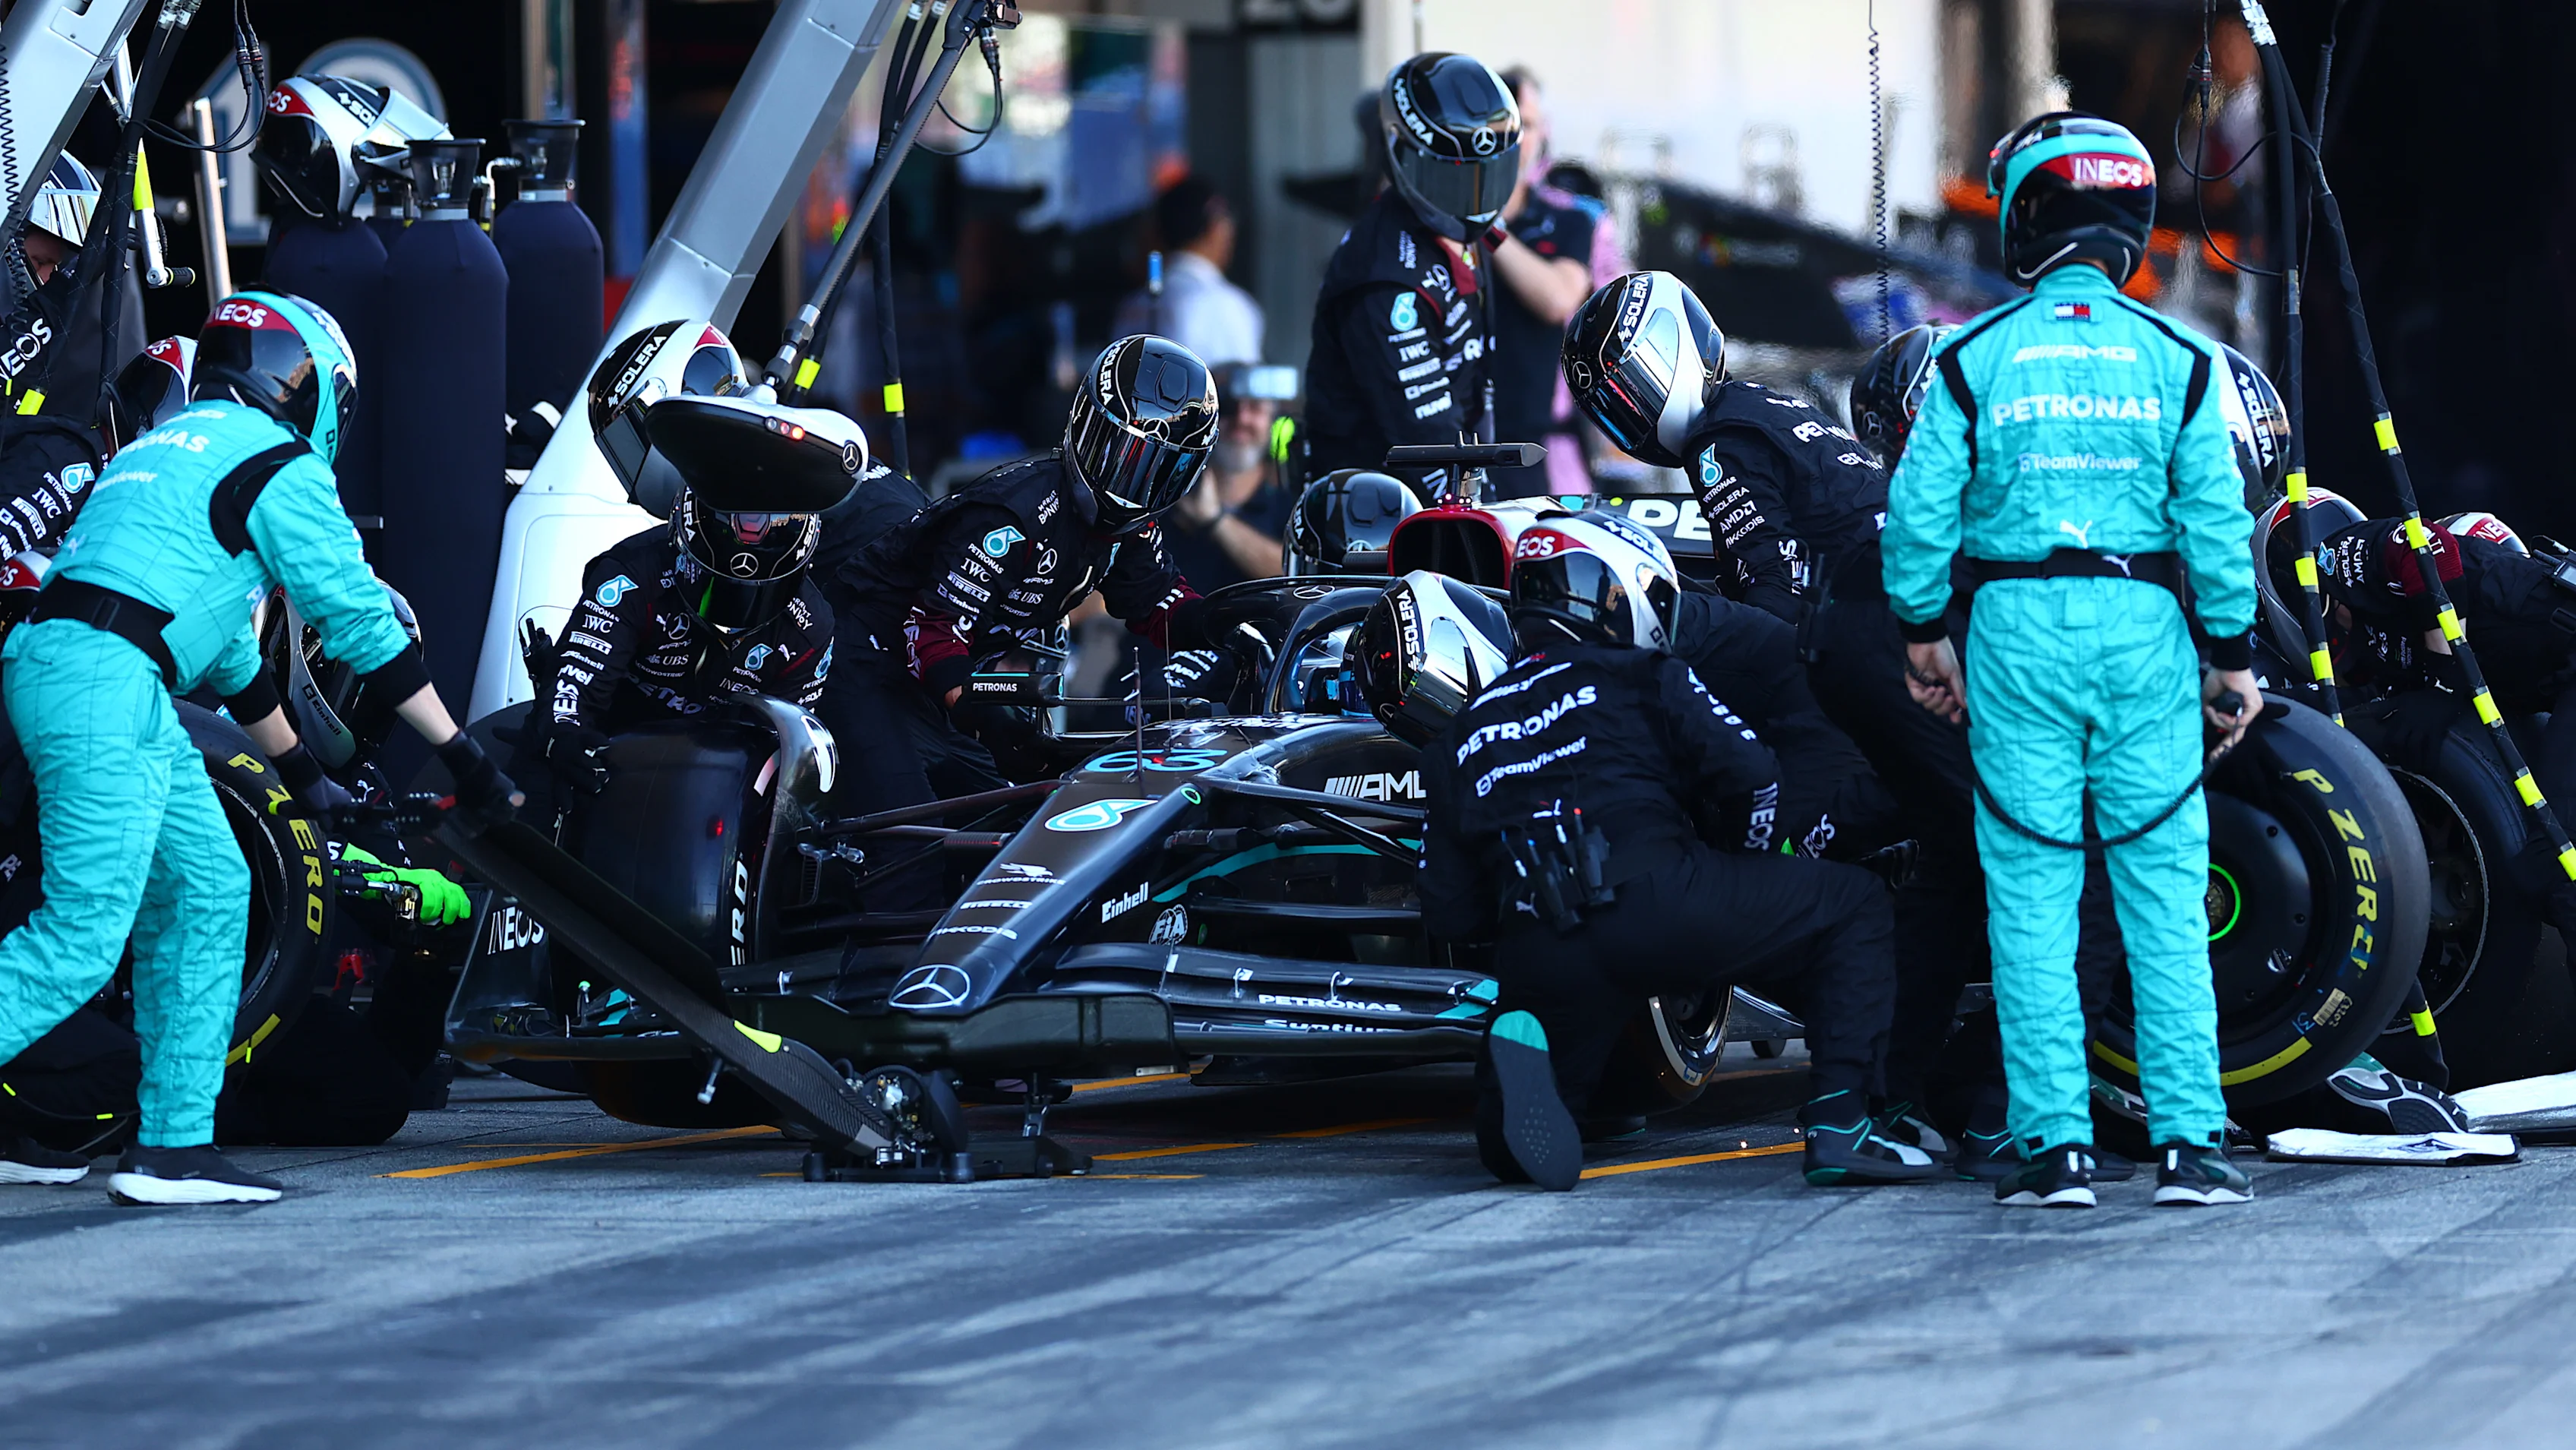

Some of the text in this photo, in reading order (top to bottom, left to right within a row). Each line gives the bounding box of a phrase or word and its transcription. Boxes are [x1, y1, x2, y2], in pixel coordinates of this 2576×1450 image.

[1394, 87, 1435, 146] SOLERA
[2074, 157, 2143, 187] INEOS
[213, 303, 267, 327] NEOS
[1623, 276, 1650, 327] SOLERA
[0, 318, 52, 381] NEOS
[614, 335, 667, 396] SOLERA
[1399, 341, 1430, 362] IWC
[2053, 345, 2137, 362] AMG
[1100, 346, 1122, 406] SOLERA
[1992, 394, 2162, 427] PETRONAS
[2242, 387, 2275, 467] SOLERA
[2033, 453, 2142, 470] TeamViewer
[32, 487, 62, 519] IWC
[43, 472, 73, 512] PETRONAS
[1703, 476, 1737, 503] PETRONAS
[1713, 487, 1750, 516] SOLERA
[11, 496, 46, 539] PIRELLI
[684, 486, 696, 542] LERA
[1719, 509, 1745, 534] AMD
[968, 543, 1004, 574] PETRONAS
[1517, 536, 1555, 558] EOS
[2341, 535, 2355, 581] SOLERA
[961, 558, 992, 582] IWC
[947, 570, 990, 603] PIRELLI
[1021, 592, 1043, 605] UBS
[582, 614, 614, 633] IWC
[1397, 589, 1421, 656] SOLERA
[569, 631, 612, 655] PIRELLI
[662, 655, 689, 665] UBS
[805, 688, 823, 703] SOLE
[973, 683, 1017, 691] PETRONAS
[312, 700, 341, 736] Einhell
[1457, 686, 1597, 768] PETRONAS
[1084, 748, 1228, 772] 63
[1489, 736, 1586, 782] TeamViewer
[1744, 782, 1778, 851] INEOS
[227, 752, 324, 936] P ZERO
[977, 877, 1066, 886] CROWDSTRIKE
[2292, 768, 2378, 971] P ZERO
[731, 860, 748, 966] ERO
[960, 900, 1033, 909] PIRELLI
[1102, 881, 1149, 924] Einhell
[1258, 994, 1403, 1012] PETRONAS
